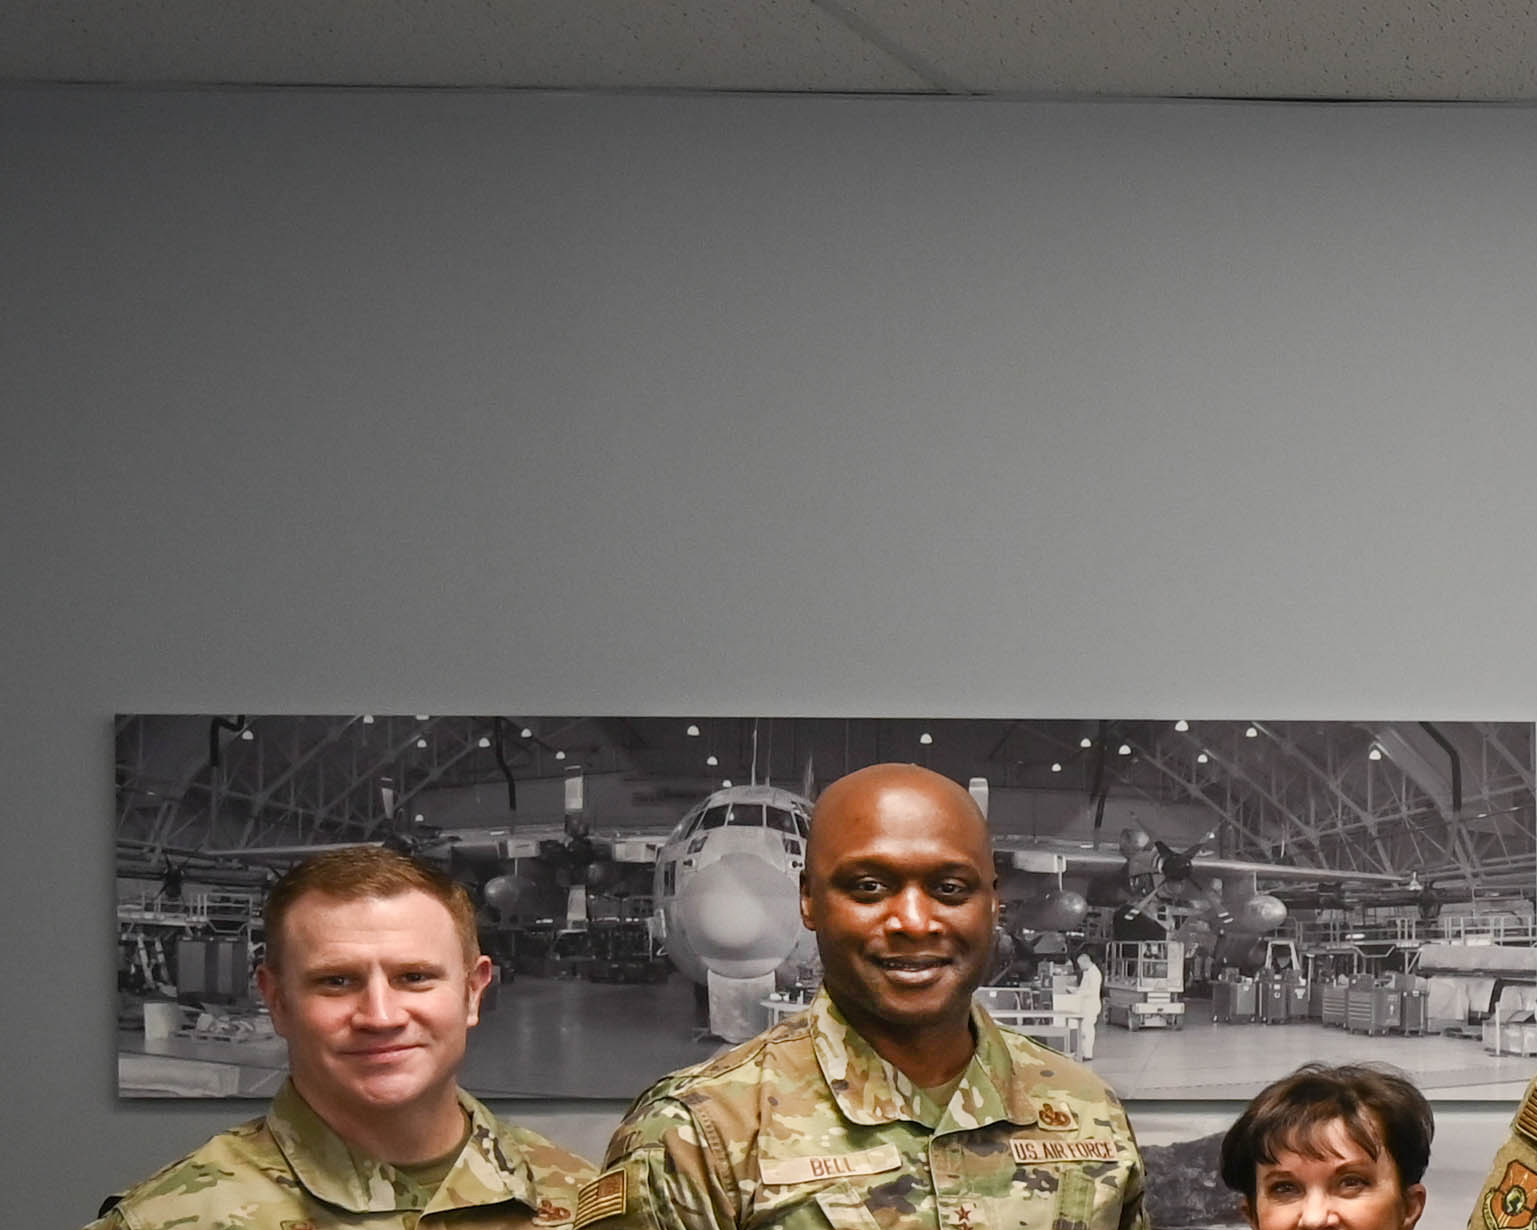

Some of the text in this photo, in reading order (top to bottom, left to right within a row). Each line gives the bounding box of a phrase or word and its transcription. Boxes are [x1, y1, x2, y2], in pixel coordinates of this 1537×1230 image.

[1042, 1142, 1068, 1160] AIR
[1068, 1142, 1114, 1159] FORCE
[809, 1157, 856, 1177] BELL
